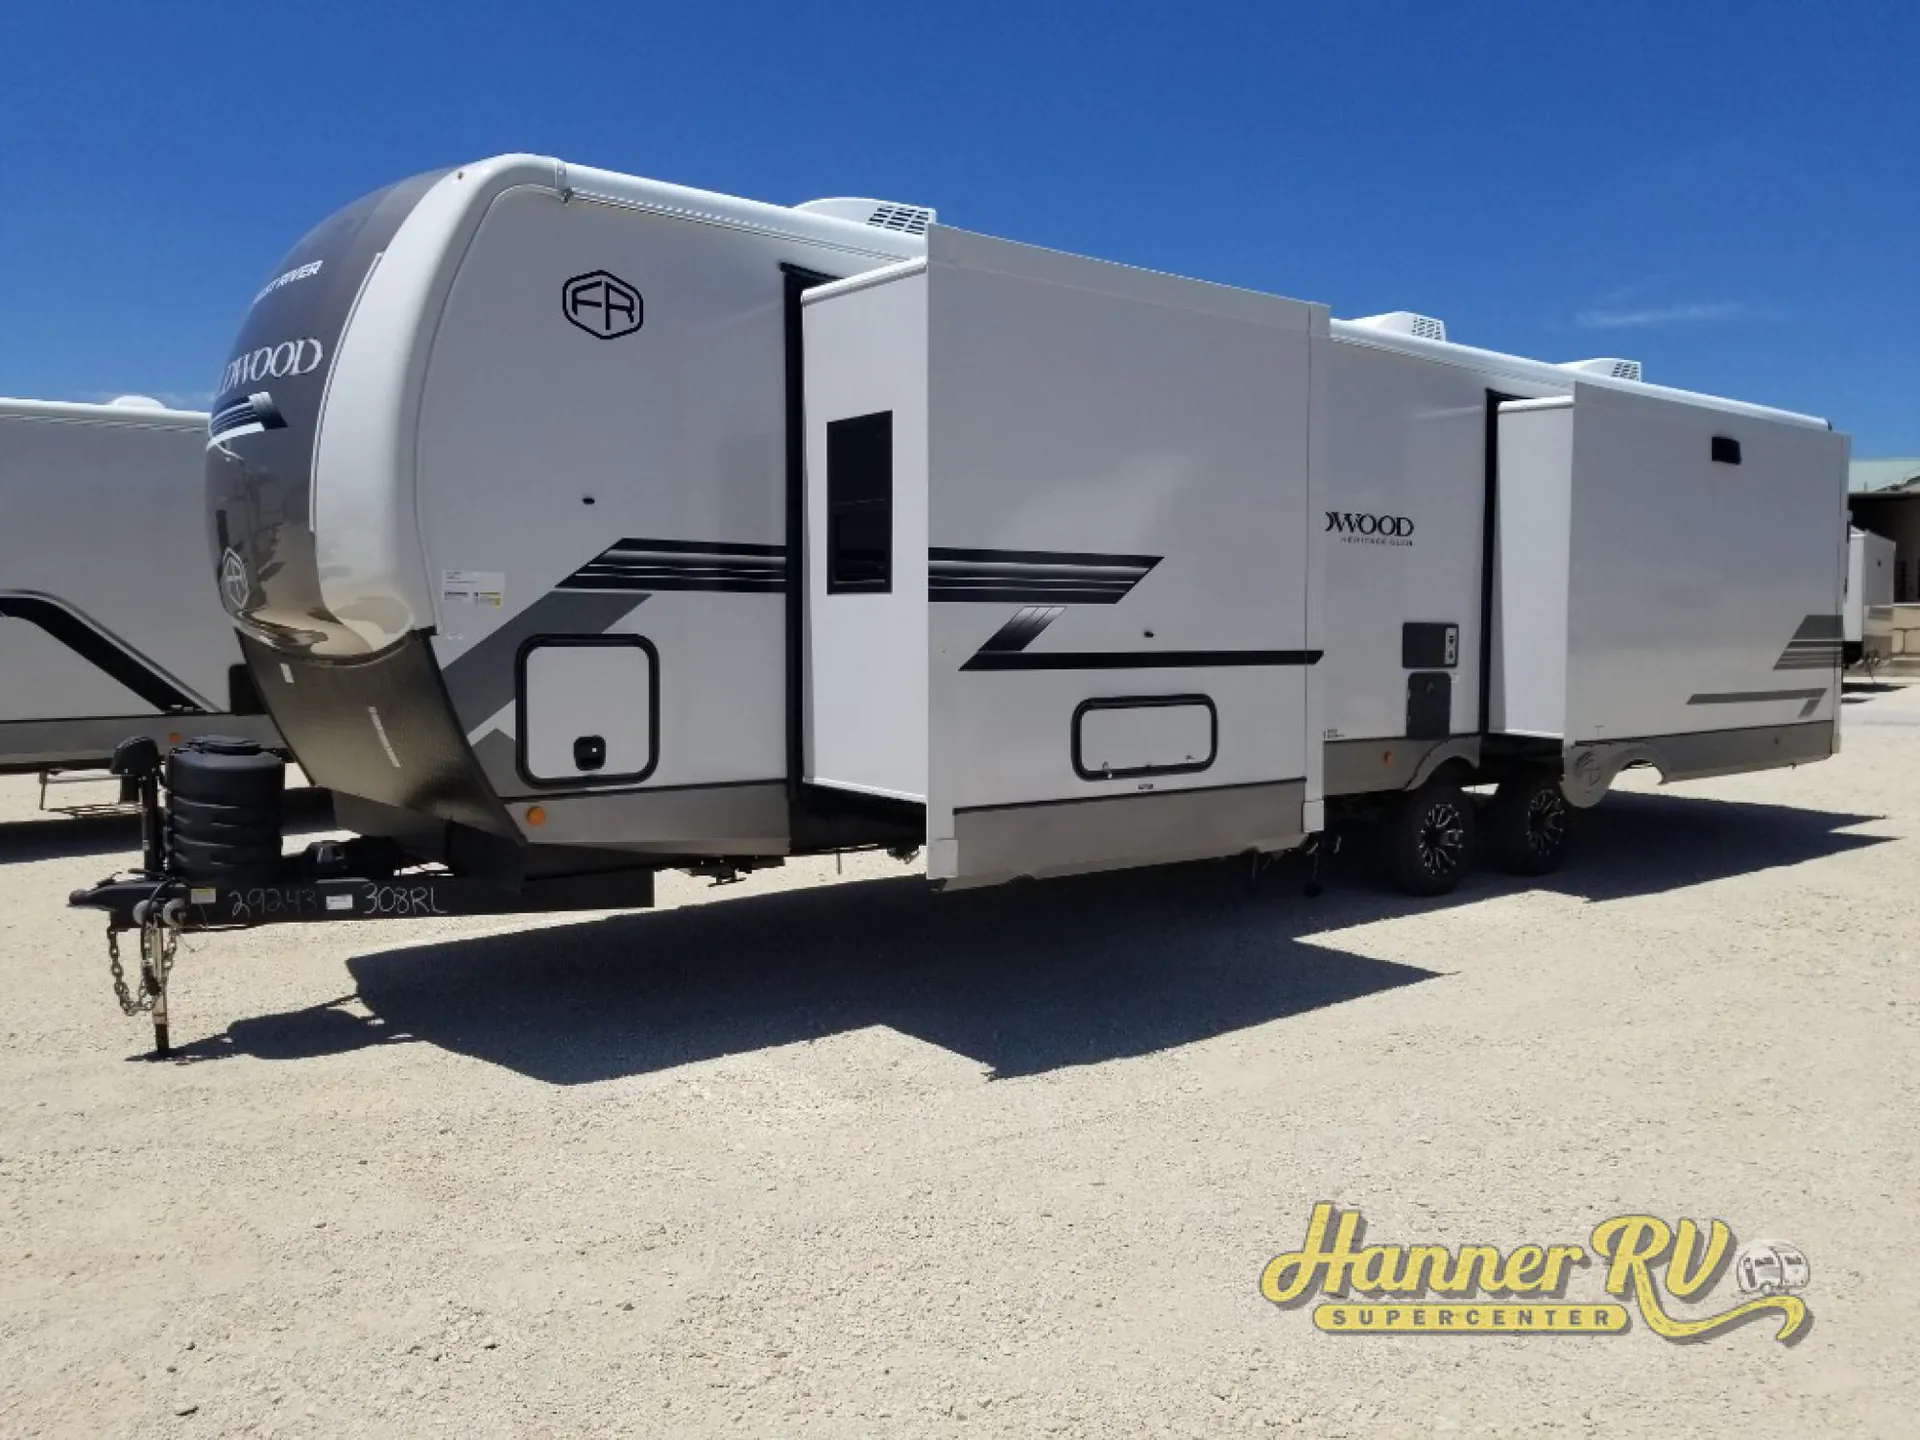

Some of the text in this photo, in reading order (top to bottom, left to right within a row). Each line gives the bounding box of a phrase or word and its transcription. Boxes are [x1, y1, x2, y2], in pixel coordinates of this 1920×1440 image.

[280, 259, 324, 287] RIVER
[228, 887, 318, 917] 29243
[362, 882, 448, 915] 308RL
